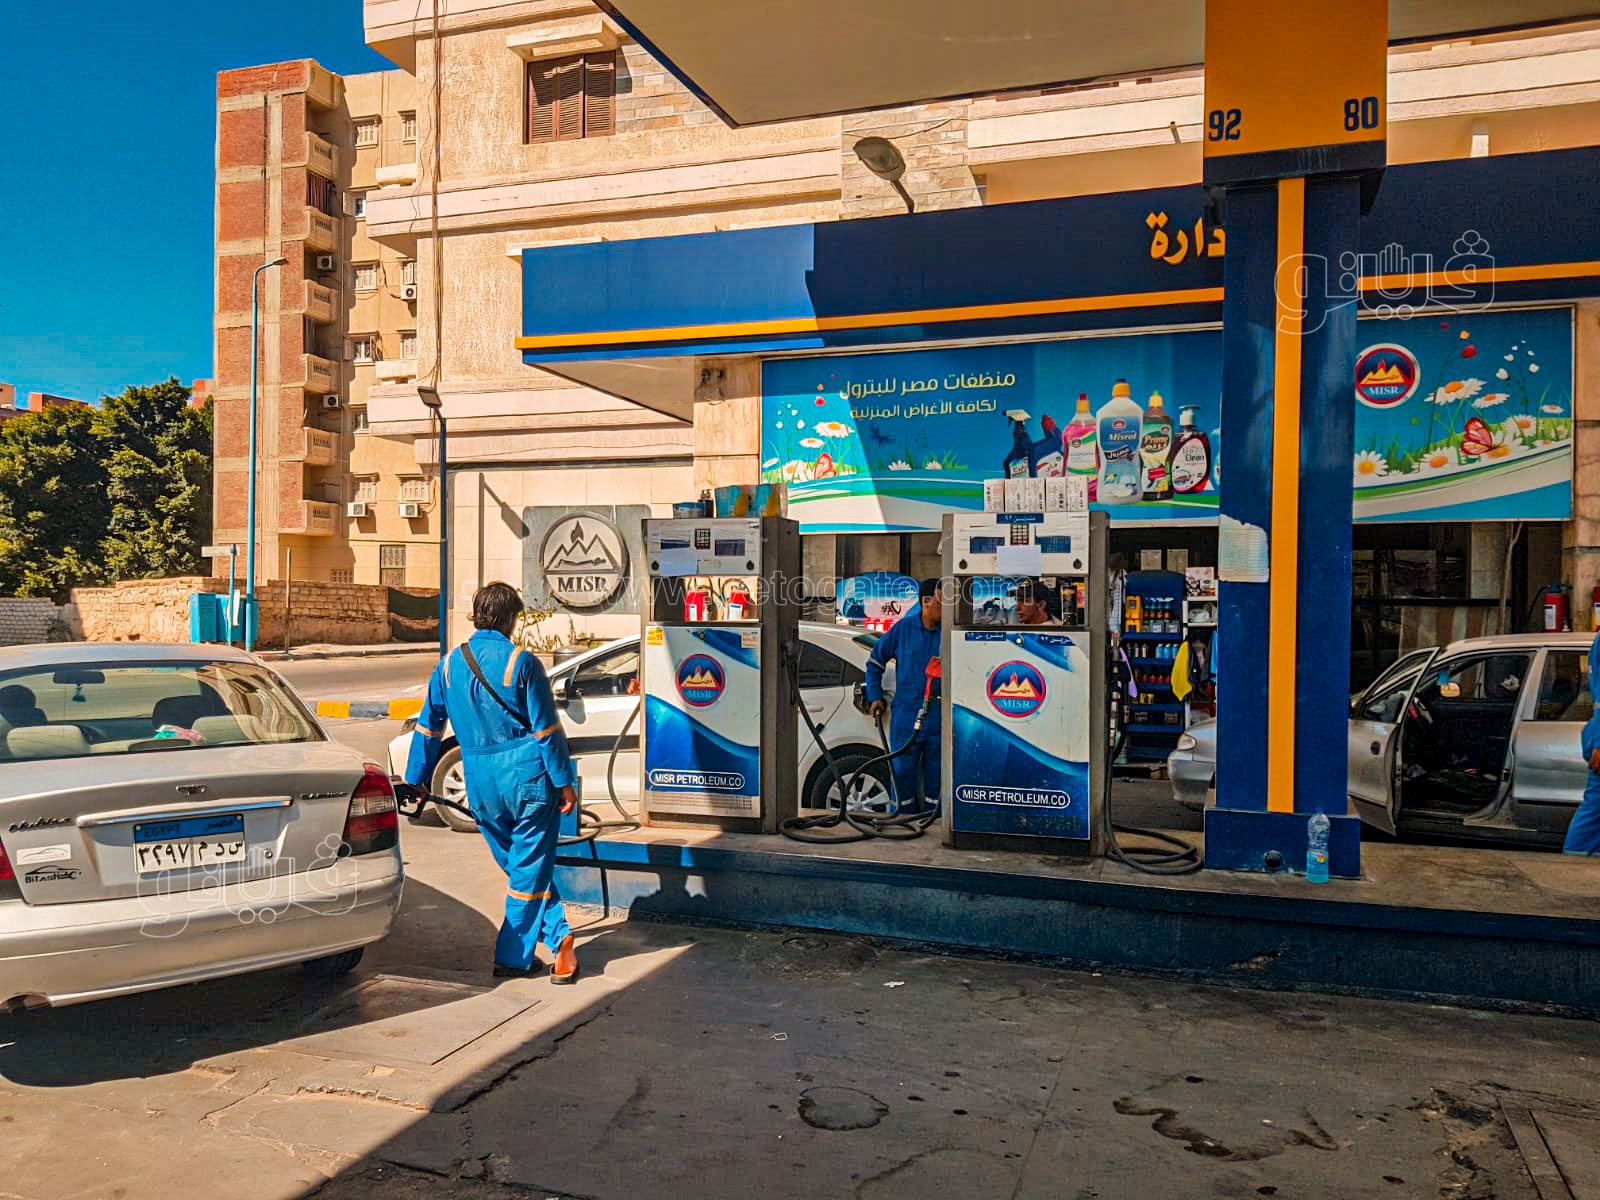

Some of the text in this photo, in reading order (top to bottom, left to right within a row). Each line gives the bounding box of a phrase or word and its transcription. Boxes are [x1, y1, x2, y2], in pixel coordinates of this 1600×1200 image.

[1343, 96, 1379, 131] 80
[1208, 109, 1241, 142] 92
[839, 371, 1016, 400] منظفات مصر للبترول
[1369, 386, 1400, 395] MISR
[850, 399, 997, 421] لكافة الأغراض المنزلية
[557, 576, 609, 592] MISR
[687, 690, 712, 698] MISR
[1001, 699, 1030, 709] MISR
[655, 773, 675, 784] MISR
[962, 789, 987, 800] MISR
[144, 822, 182, 838] EGYPT
